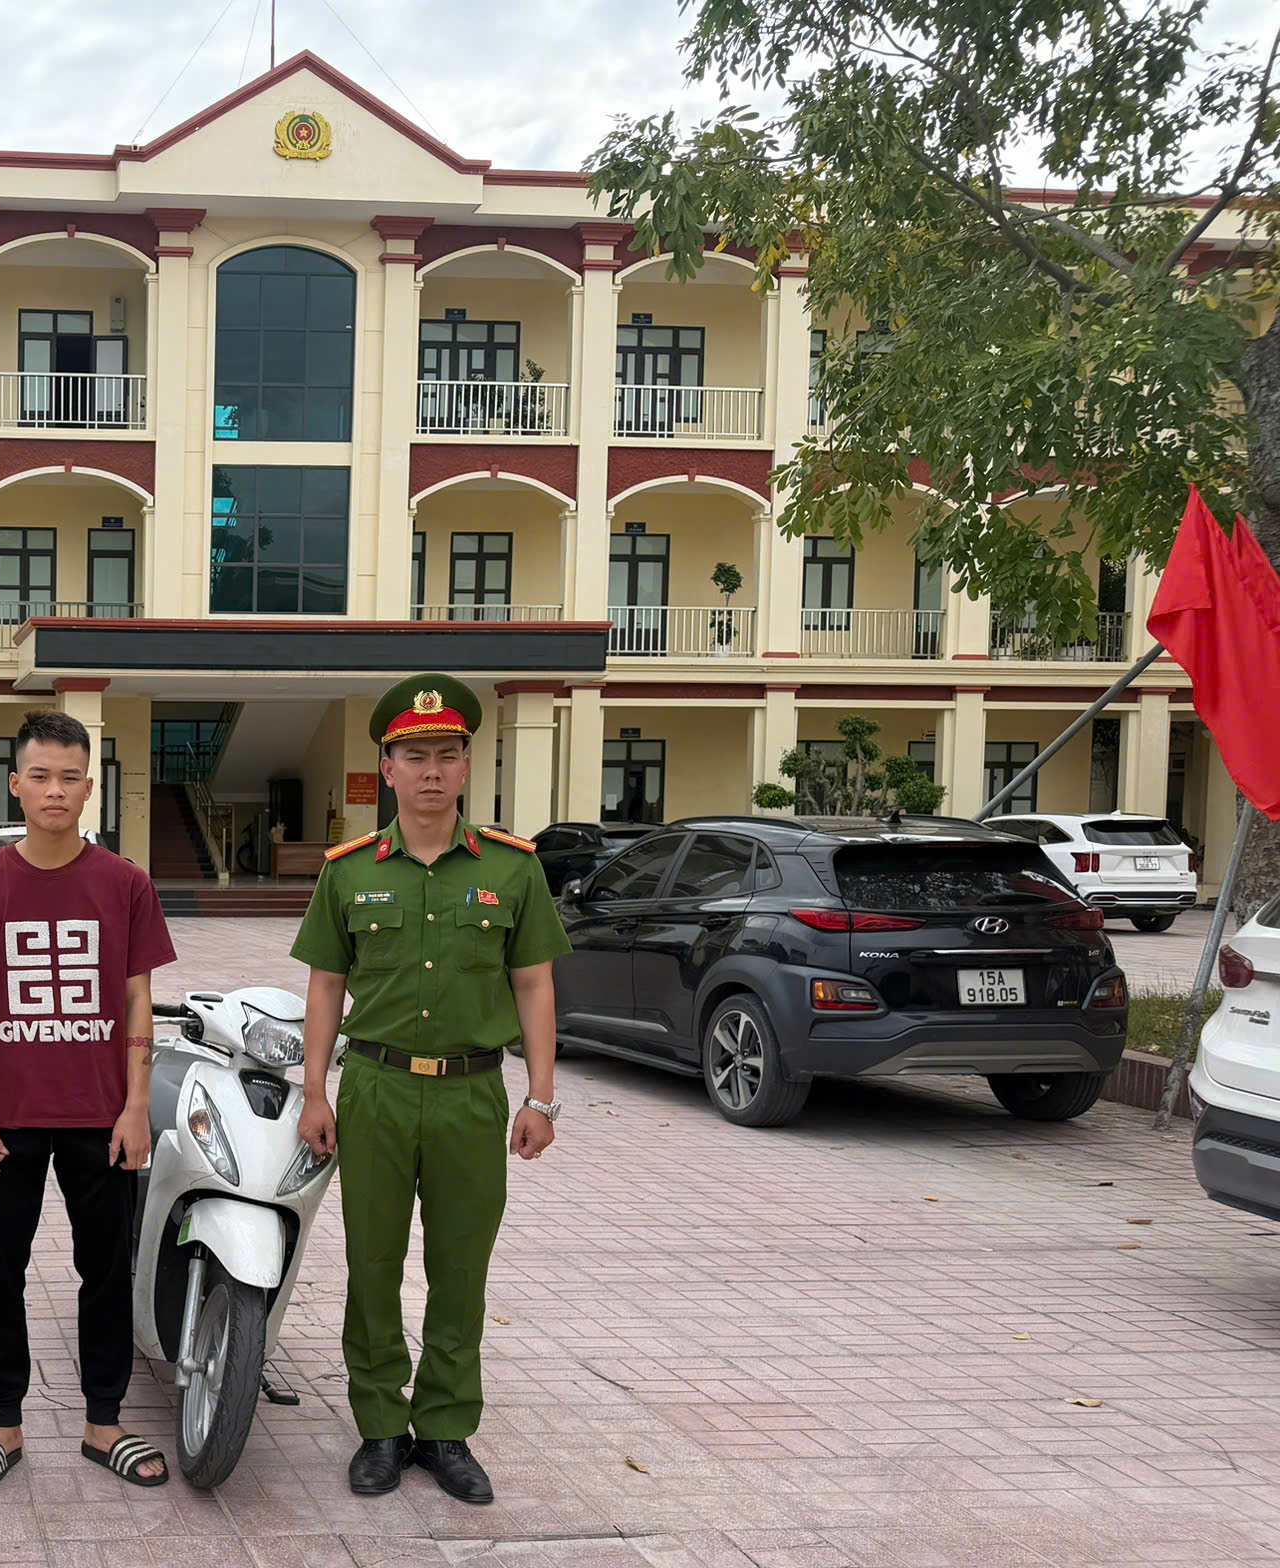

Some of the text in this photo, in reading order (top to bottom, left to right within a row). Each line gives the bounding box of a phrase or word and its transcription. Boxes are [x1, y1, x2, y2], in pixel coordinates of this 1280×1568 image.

[859, 951, 900, 959] KONA
[978, 971, 1005, 986] 15A
[966, 987, 1018, 1003] 918.05
